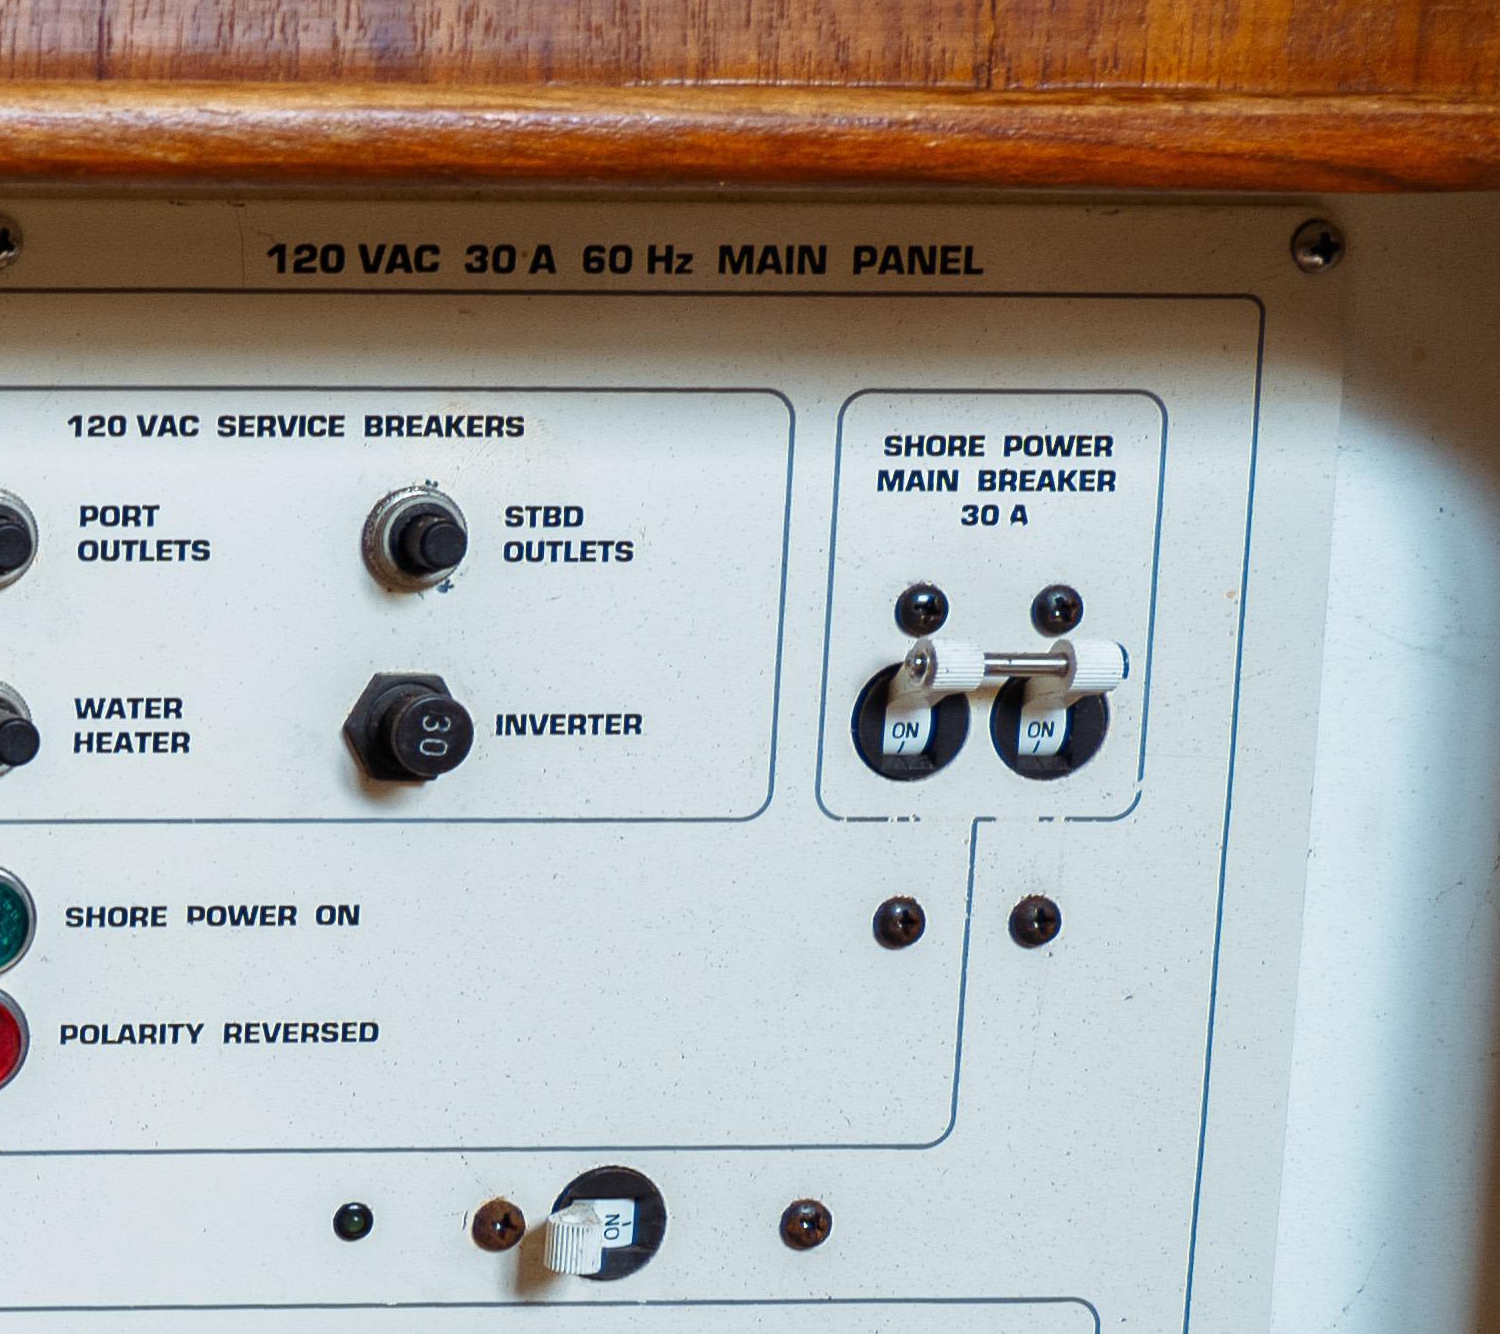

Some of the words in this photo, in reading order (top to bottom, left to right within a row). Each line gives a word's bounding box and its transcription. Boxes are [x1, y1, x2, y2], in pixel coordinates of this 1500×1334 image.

[266, 243, 346, 274] 120
[358, 243, 441, 275] VAC
[464, 244, 517, 275] 30
[528, 244, 557, 275] A
[582, 244, 633, 275] 60
[647, 244, 694, 275] Hz
[718, 244, 828, 275] MAIN
[852, 244, 984, 276] PANEL
[67, 415, 127, 438] 120
[136, 414, 200, 437] VAC
[217, 415, 346, 438] SERVICE
[364, 415, 525, 438] BREAKERS
[883, 434, 986, 457] SHORE
[1003, 434, 1114, 458] POWER
[876, 469, 959, 492] MAIN
[977, 468, 1117, 492] BREAKER
[79, 504, 161, 528] PORT
[504, 505, 584, 528] STBD
[960, 504, 1000, 527] 30
[1009, 504, 1029, 526] A
[77, 539, 211, 562] OUTLETS
[503, 540, 634, 563] OUTLETS
[74, 697, 183, 720] WATER
[419, 715, 451, 757] 30
[495, 713, 643, 736] INVERTER
[891, 721, 919, 741] ON
[1027, 720, 1055, 740] ON
[73, 731, 191, 754] HEATER
[65, 905, 168, 928] SHORE
[186, 905, 298, 927] POWER
[315, 904, 360, 926] ON
[59, 1023, 205, 1045] POLARITY
[223, 1021, 379, 1044] REVERSED
[603, 1213, 621, 1241] ON
